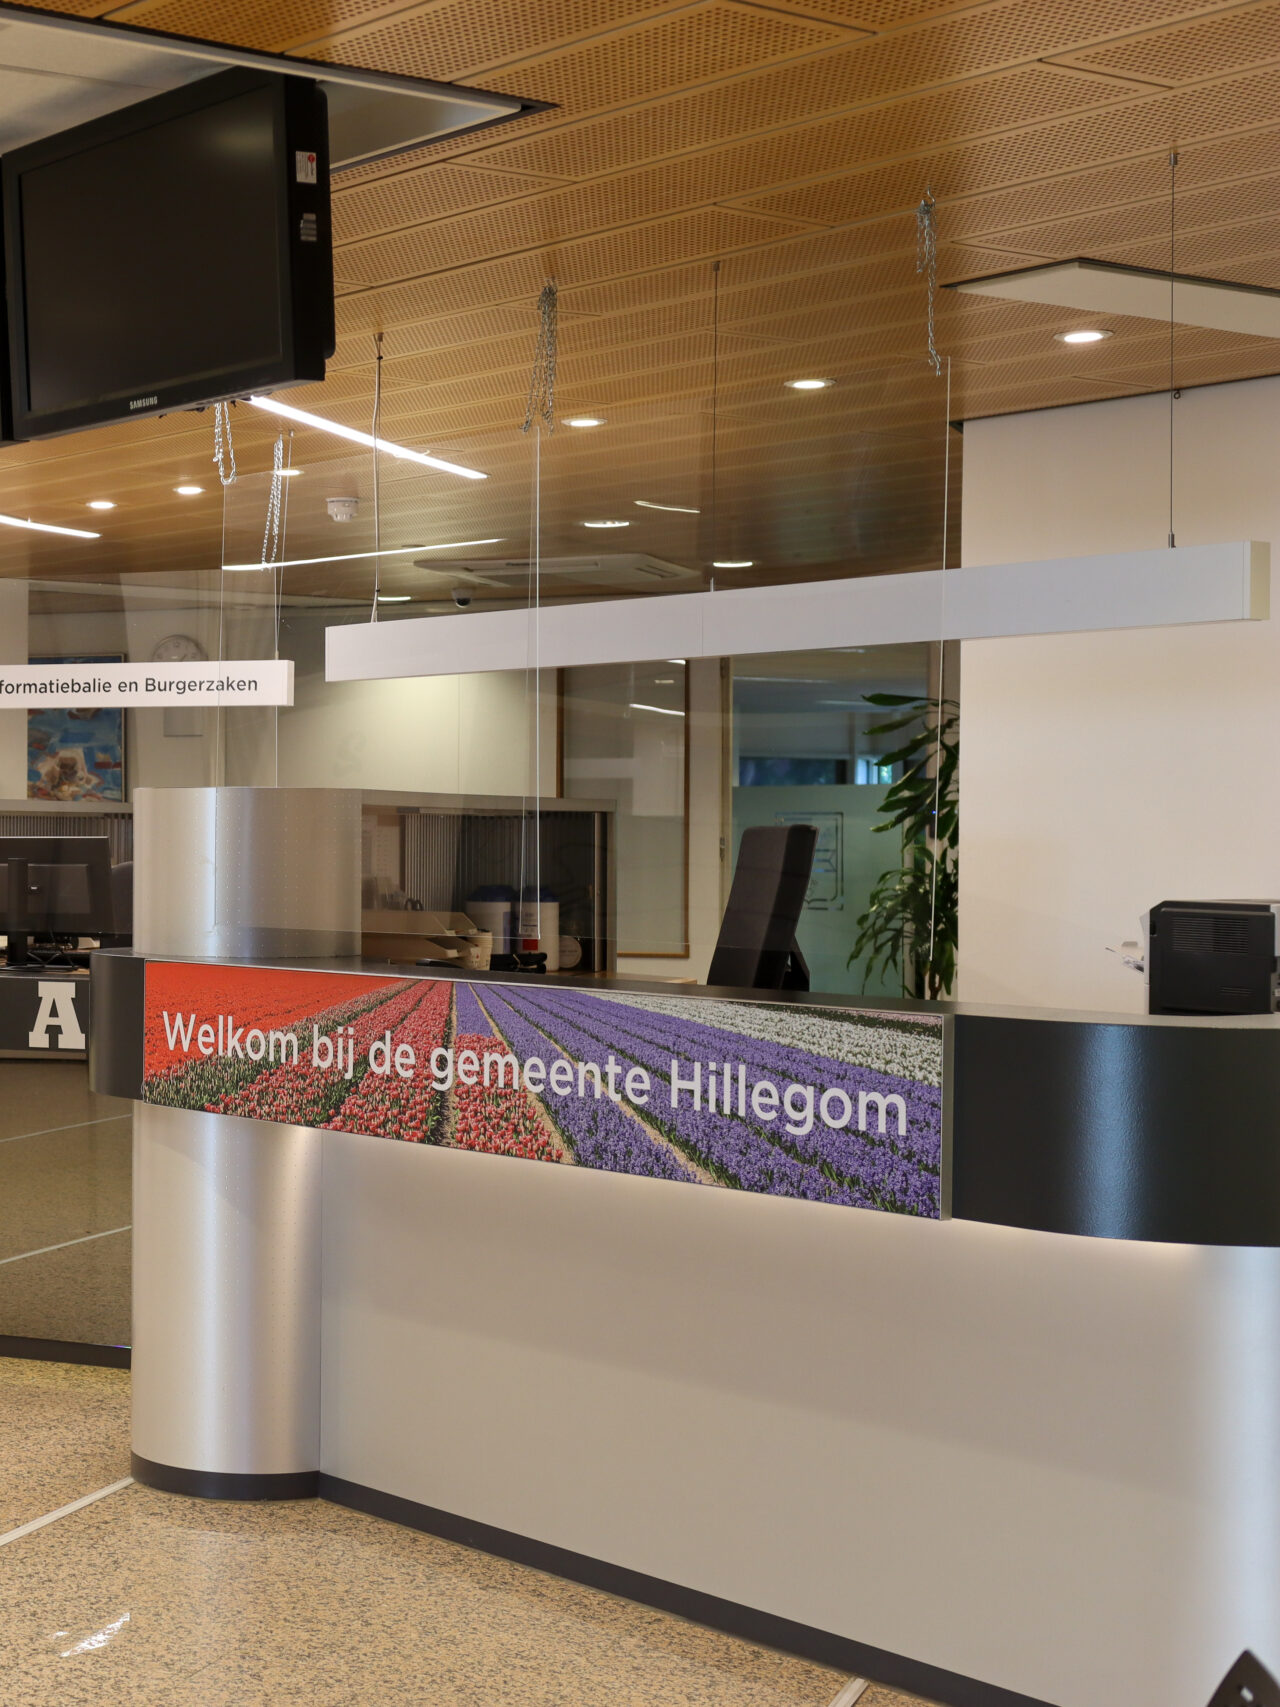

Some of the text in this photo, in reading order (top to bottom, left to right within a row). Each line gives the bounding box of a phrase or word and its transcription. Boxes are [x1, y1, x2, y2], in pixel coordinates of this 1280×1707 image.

[129, 396, 158, 410] SAMSUNG
[118, 680, 138, 693] en
[145, 677, 258, 695] Burgerzaken
[28, 981, 86, 1050] A
[162, 1010, 907, 1136] Welkom bij de gemeente Hillegom
